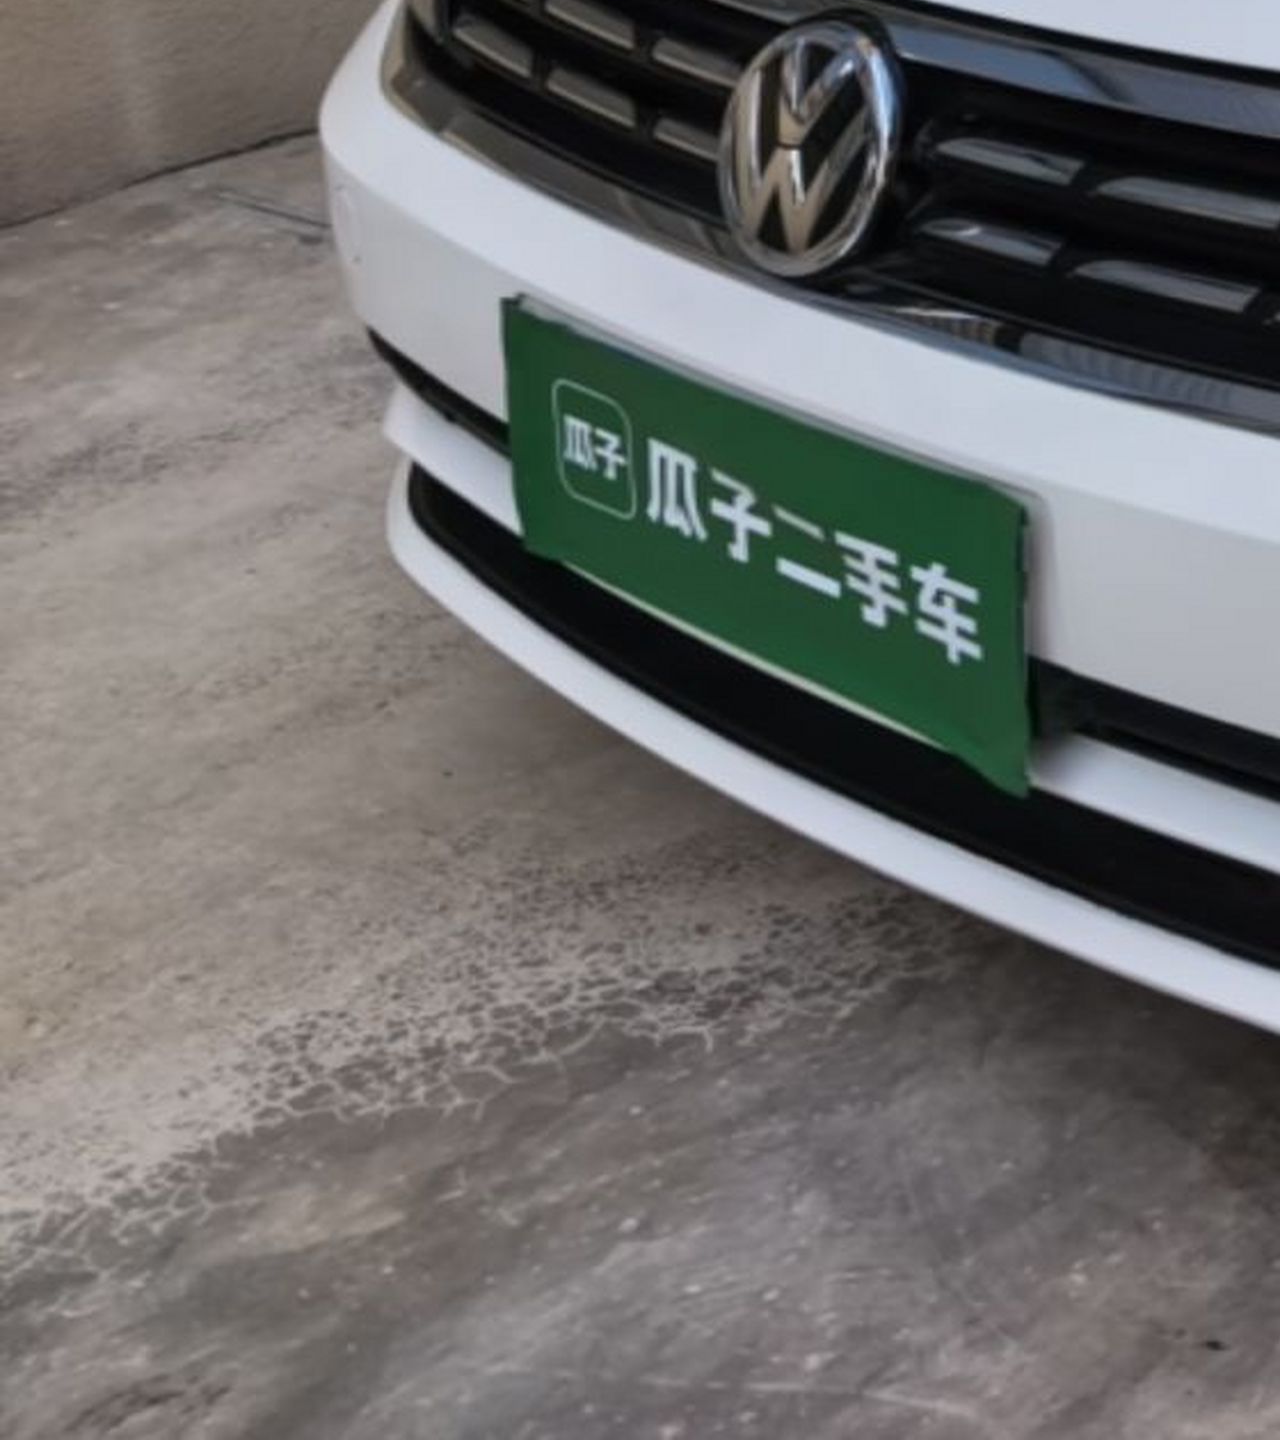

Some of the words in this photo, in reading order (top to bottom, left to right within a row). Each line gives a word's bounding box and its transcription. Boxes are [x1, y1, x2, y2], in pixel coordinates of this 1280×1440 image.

[562, 415, 628, 480] 瓜子
[646, 437, 983, 665] 瓜子二手车
